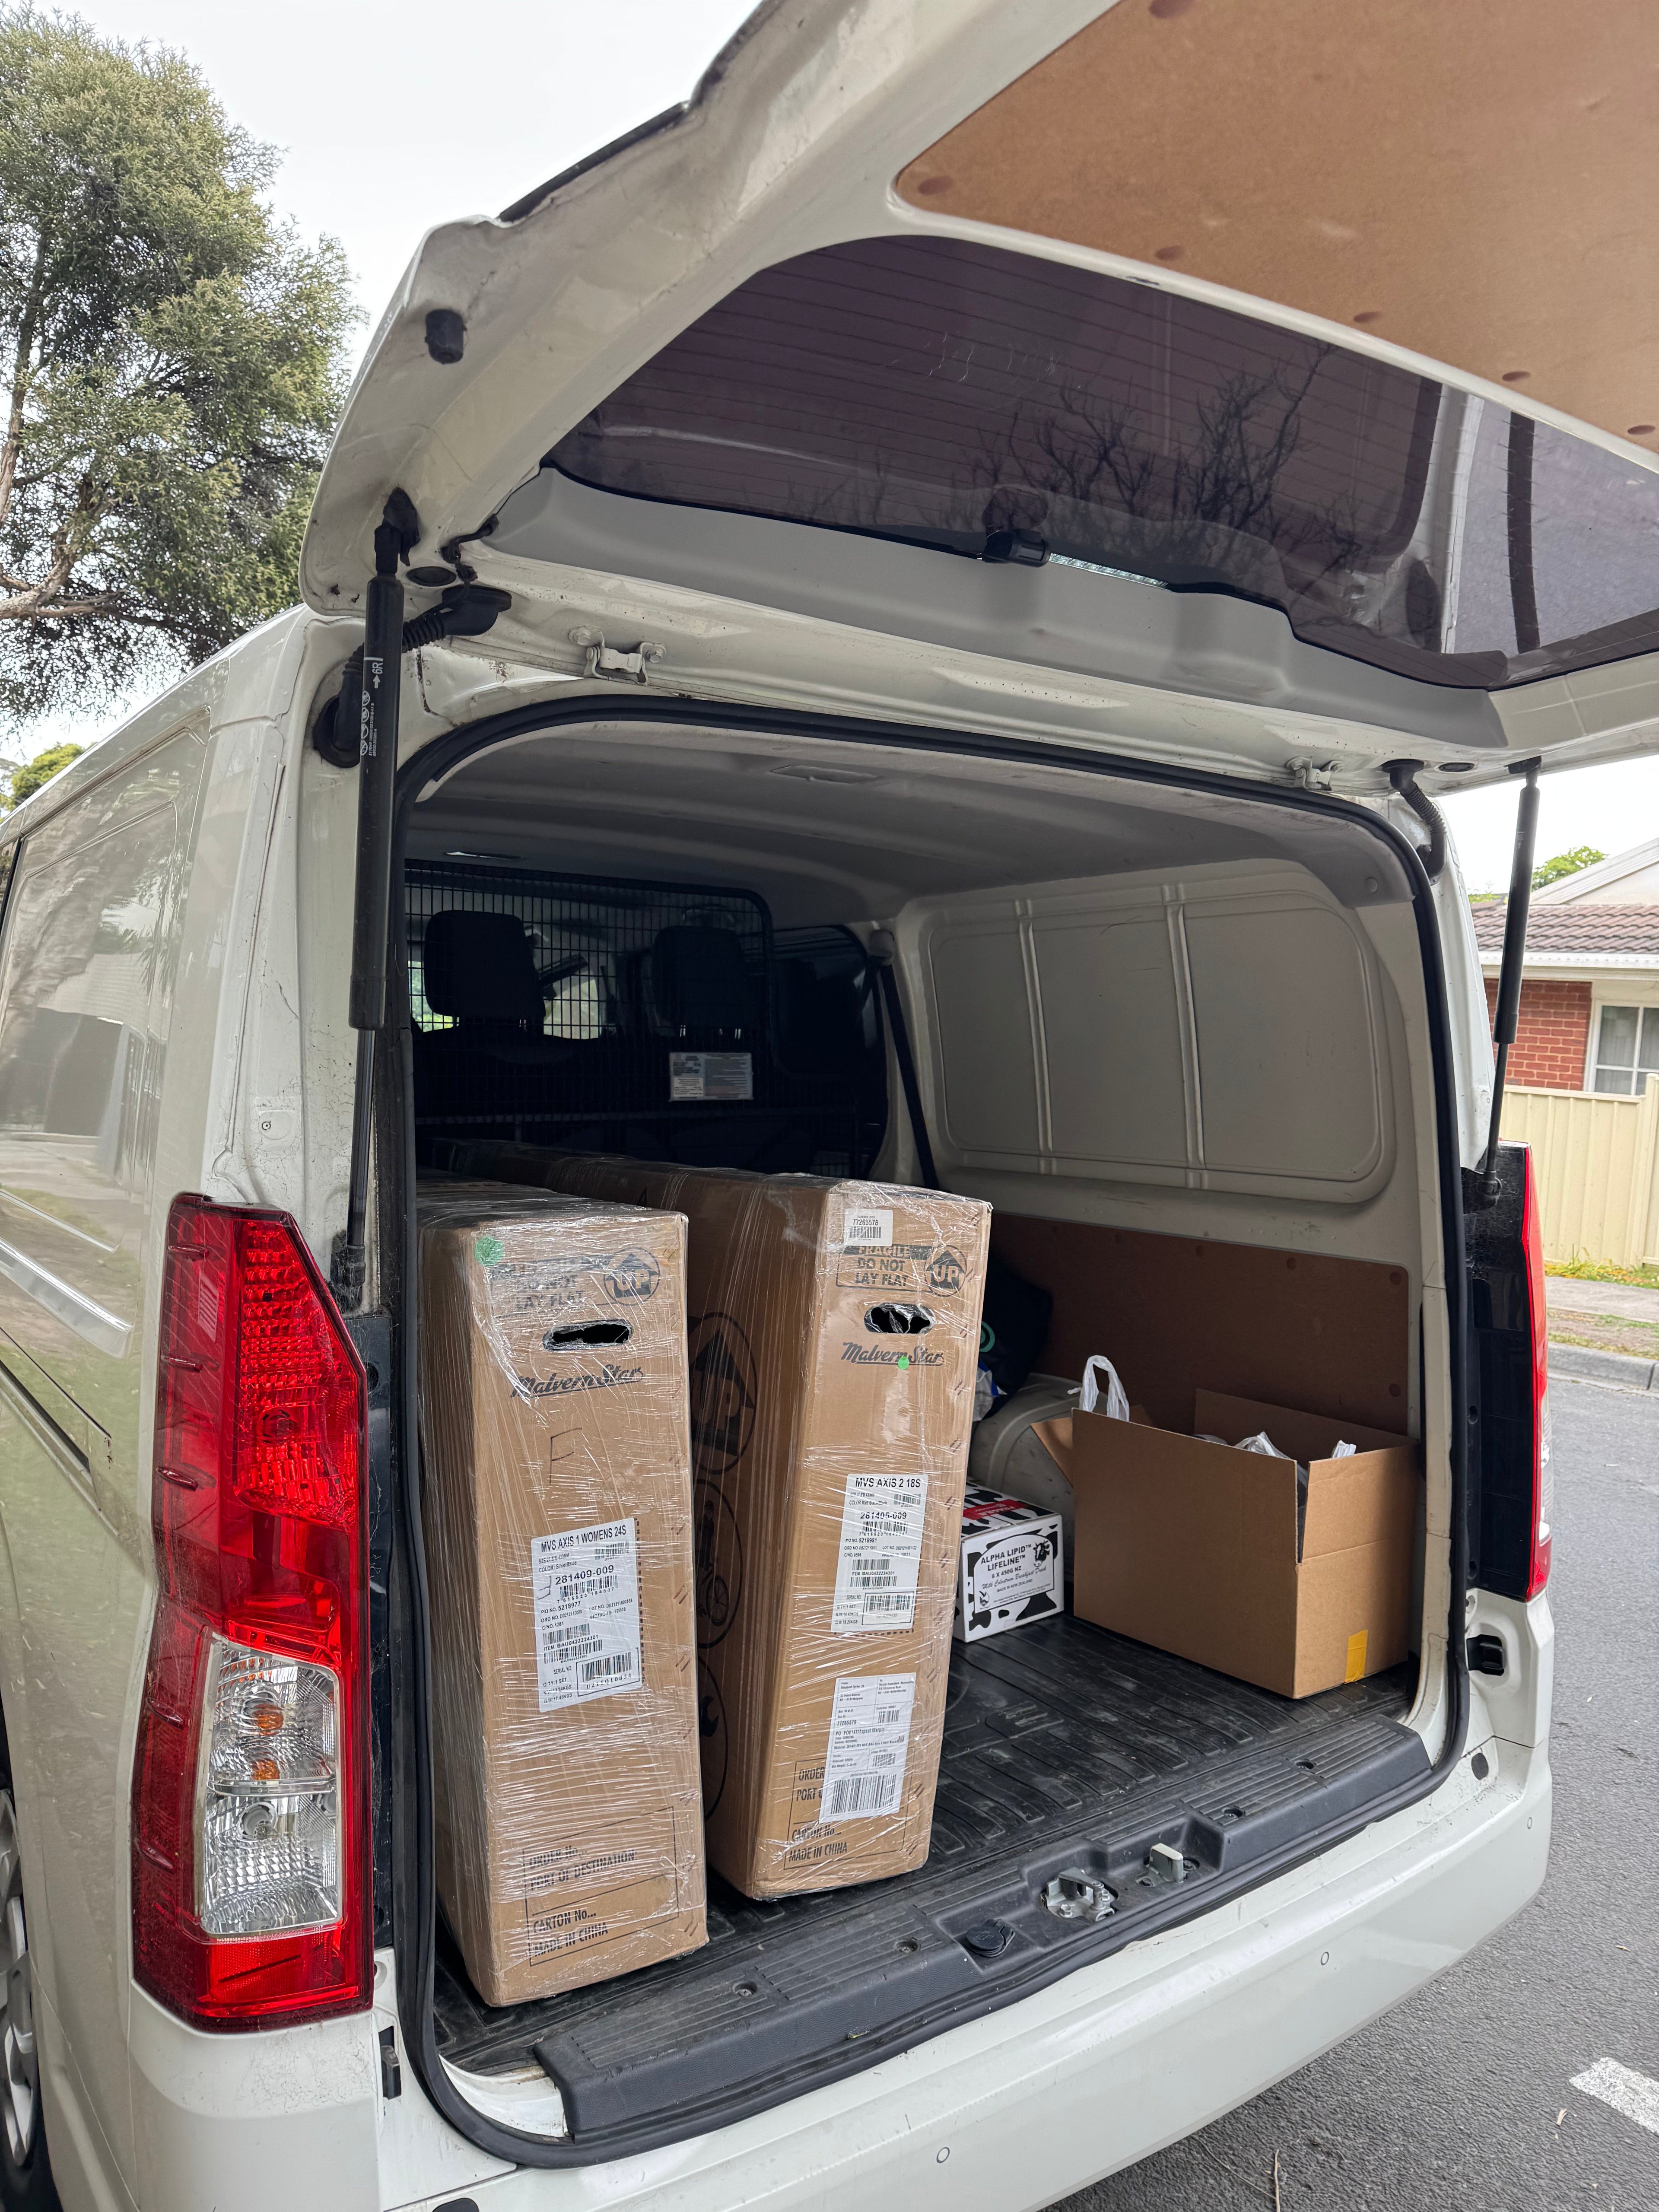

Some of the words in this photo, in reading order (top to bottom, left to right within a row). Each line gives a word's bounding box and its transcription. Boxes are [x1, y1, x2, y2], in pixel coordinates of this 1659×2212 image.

[858, 1246, 909, 1257] FRAGILE
[858, 1257, 876, 1269] DO
[880, 1259, 905, 1271] NOT
[615, 1268, 649, 1292] UP
[855, 1272, 879, 1284] LAY
[882, 1274, 909, 1286] FLAT
[933, 1265, 959, 1282] UP
[841, 1342, 908, 1363] Malvern
[908, 1345, 944, 1365] Star
[597, 1364, 643, 1385] Star
[855, 1478, 874, 1487] MVS
[876, 1478, 896, 1487] AXIS
[899, 1478, 903, 1487] 2
[907, 1478, 921, 1487] 18S
[541, 1540, 556, 1552] MVS
[558, 1536, 574, 1548] AXIS
[576, 1535, 579, 1545] 1
[581, 1528, 612, 1543] WOMENS
[614, 1525, 626, 1537] 24S
[981, 1552, 1005, 1564] ALPHA
[555, 1565, 614, 1585] 281409-009
[995, 1578, 1014, 1587] Colostrum
[1015, 1570, 1034, 1580] Breakfast
[558, 1601, 581, 1611] 5218977
[799, 1767, 826, 1781] ORDER
[797, 1788, 817, 1802] PORT
[789, 1847, 812, 1862] MADE
[814, 1846, 823, 1858] IN
[824, 1842, 847, 1856] CHINA
[534, 1911, 571, 1933] CARTON
[534, 1939, 563, 1957] MADE
[566, 1932, 576, 1947] IN
[579, 1922, 608, 1942] CHINA
